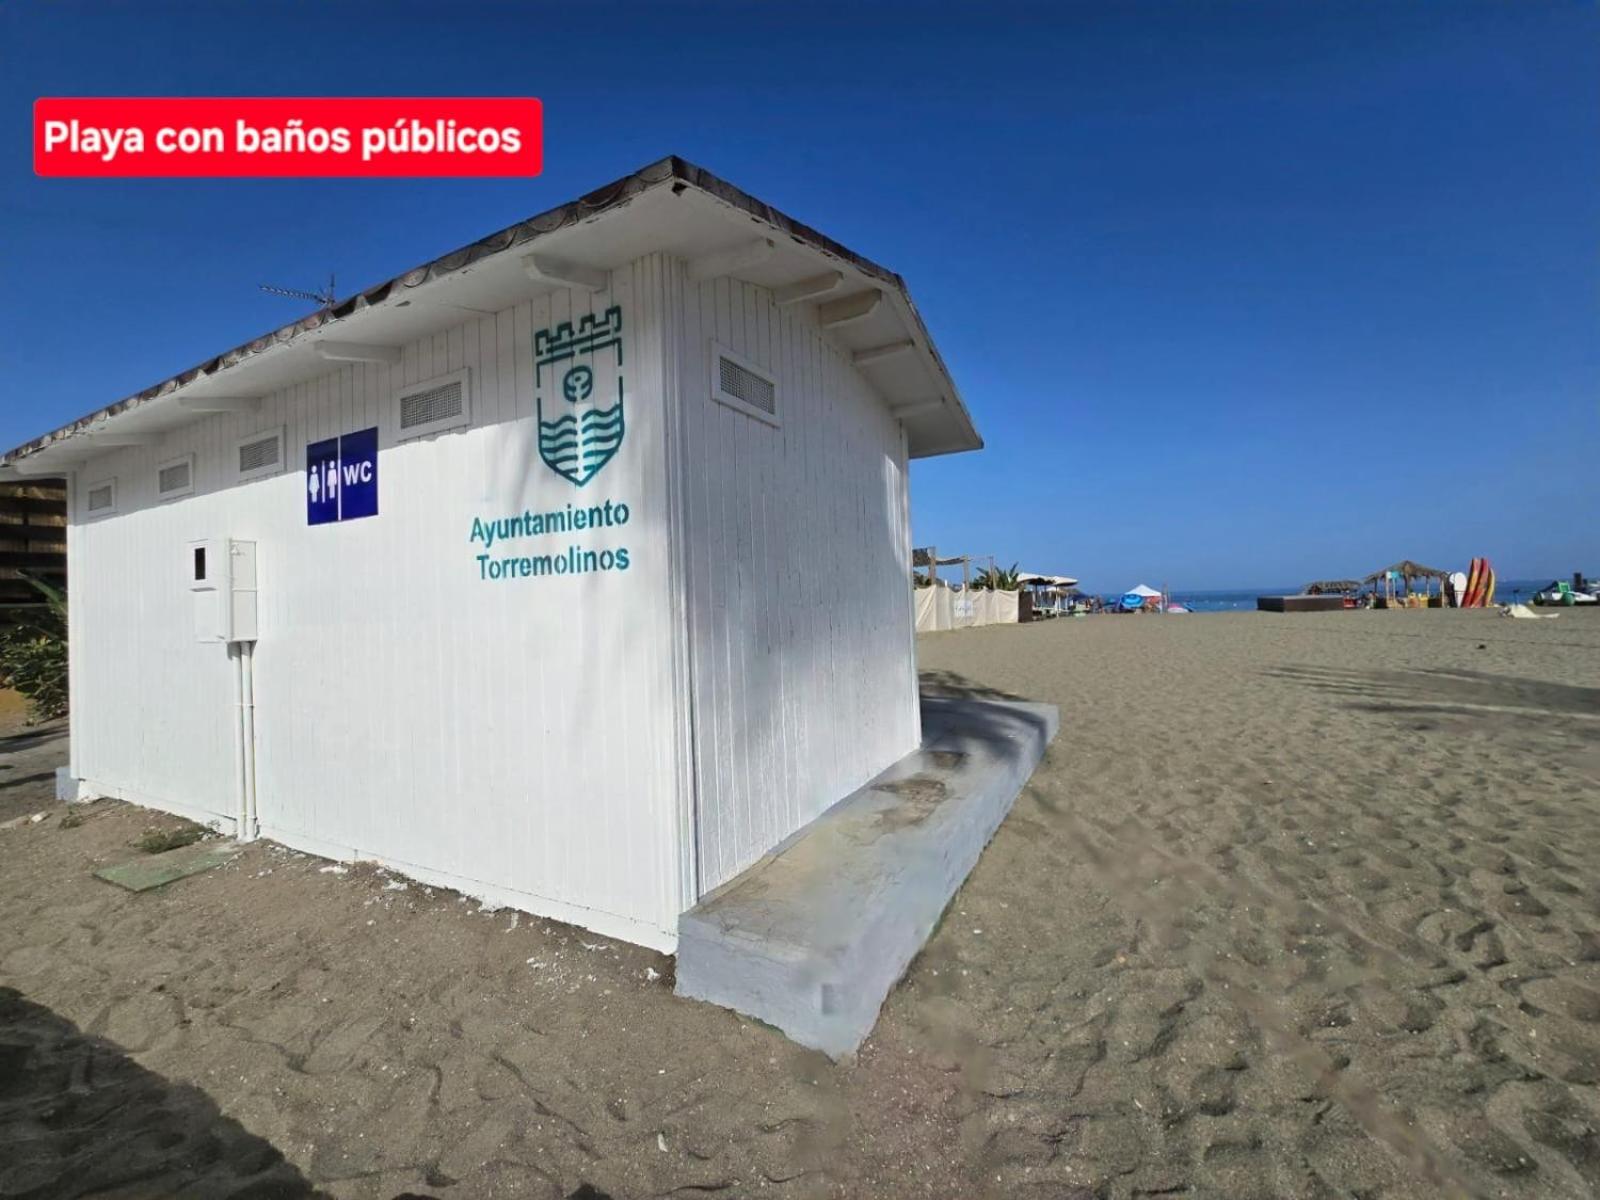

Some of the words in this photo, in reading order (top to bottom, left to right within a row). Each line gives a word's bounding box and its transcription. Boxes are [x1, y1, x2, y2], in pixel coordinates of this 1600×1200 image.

[343, 461, 372, 486] WC
[469, 498, 630, 548] Ayuntamiento
[476, 546, 630, 580] Torremolinos
